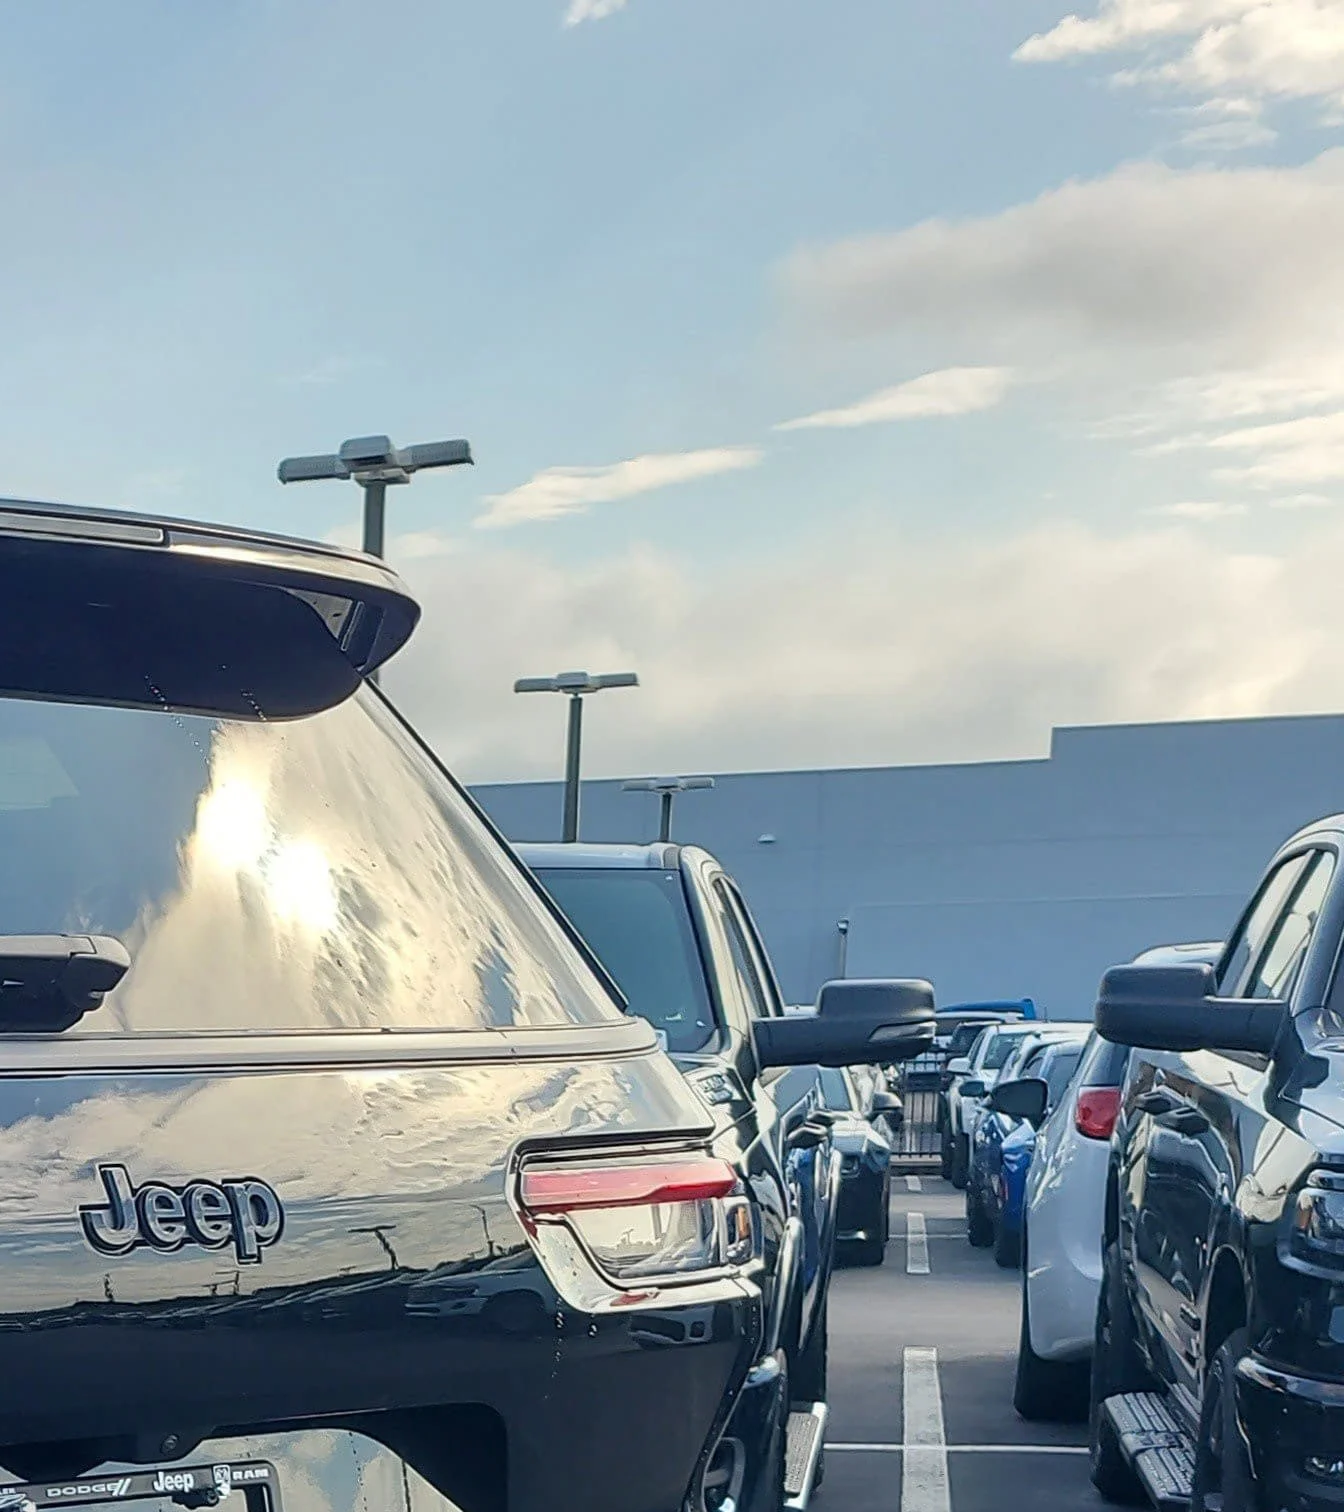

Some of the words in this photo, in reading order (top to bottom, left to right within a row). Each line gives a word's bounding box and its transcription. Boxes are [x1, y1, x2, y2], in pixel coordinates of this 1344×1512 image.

[78, 1162, 285, 1265] Jeep
[47, 1482, 118, 1498] DODGE
[153, 1471, 195, 1493] Jeep
[232, 1468, 269, 1480] RAM
